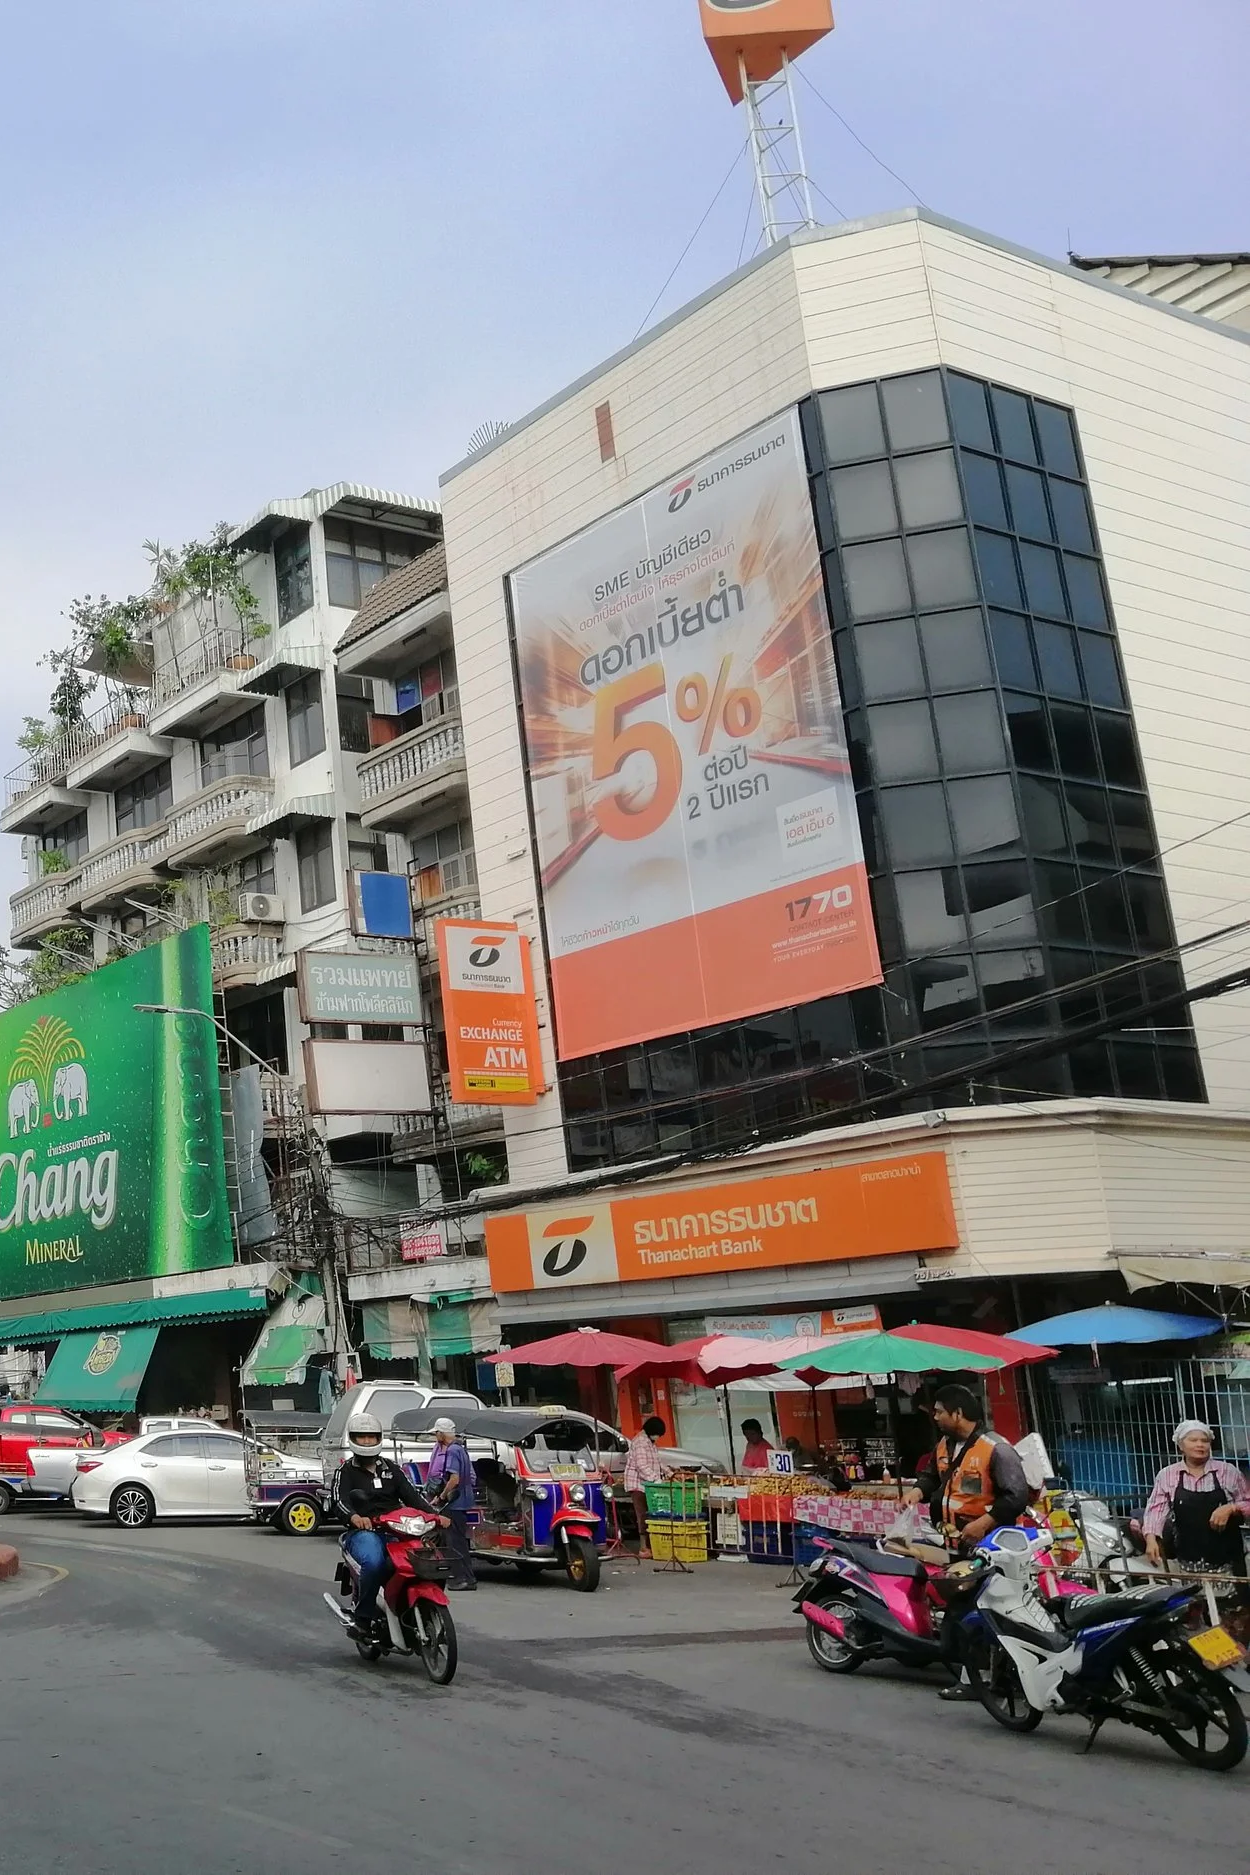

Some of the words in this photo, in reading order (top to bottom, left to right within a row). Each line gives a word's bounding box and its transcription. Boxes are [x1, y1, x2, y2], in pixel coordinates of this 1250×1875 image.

[697, 434, 786, 493] ธนาคารธนชาต
[594, 570, 630, 602] SME
[635, 528, 711, 580] บัญชีเดียว
[580, 570, 745, 686] ดอกเบี้ยต่ำ
[591, 651, 762, 842] 5%
[703, 744, 749, 782] ต่อปี
[687, 795, 702, 821] 2
[706, 772, 770, 811] ปีแรก
[785, 885, 853, 921] 1770
[824, 910, 854, 924] CENTER
[310, 963, 412, 989] รวมแพทย์
[460, 1026, 524, 1042] EXCHANGE
[492, 1017, 523, 1029] Currency
[484, 1046, 528, 1069] ATM
[634, 1197, 818, 1245] ธนาคารธนชาต
[638, 1243, 718, 1266] Thanachart
[721, 1236, 763, 1256] Bank
[775, 1453, 791, 1473] 30
